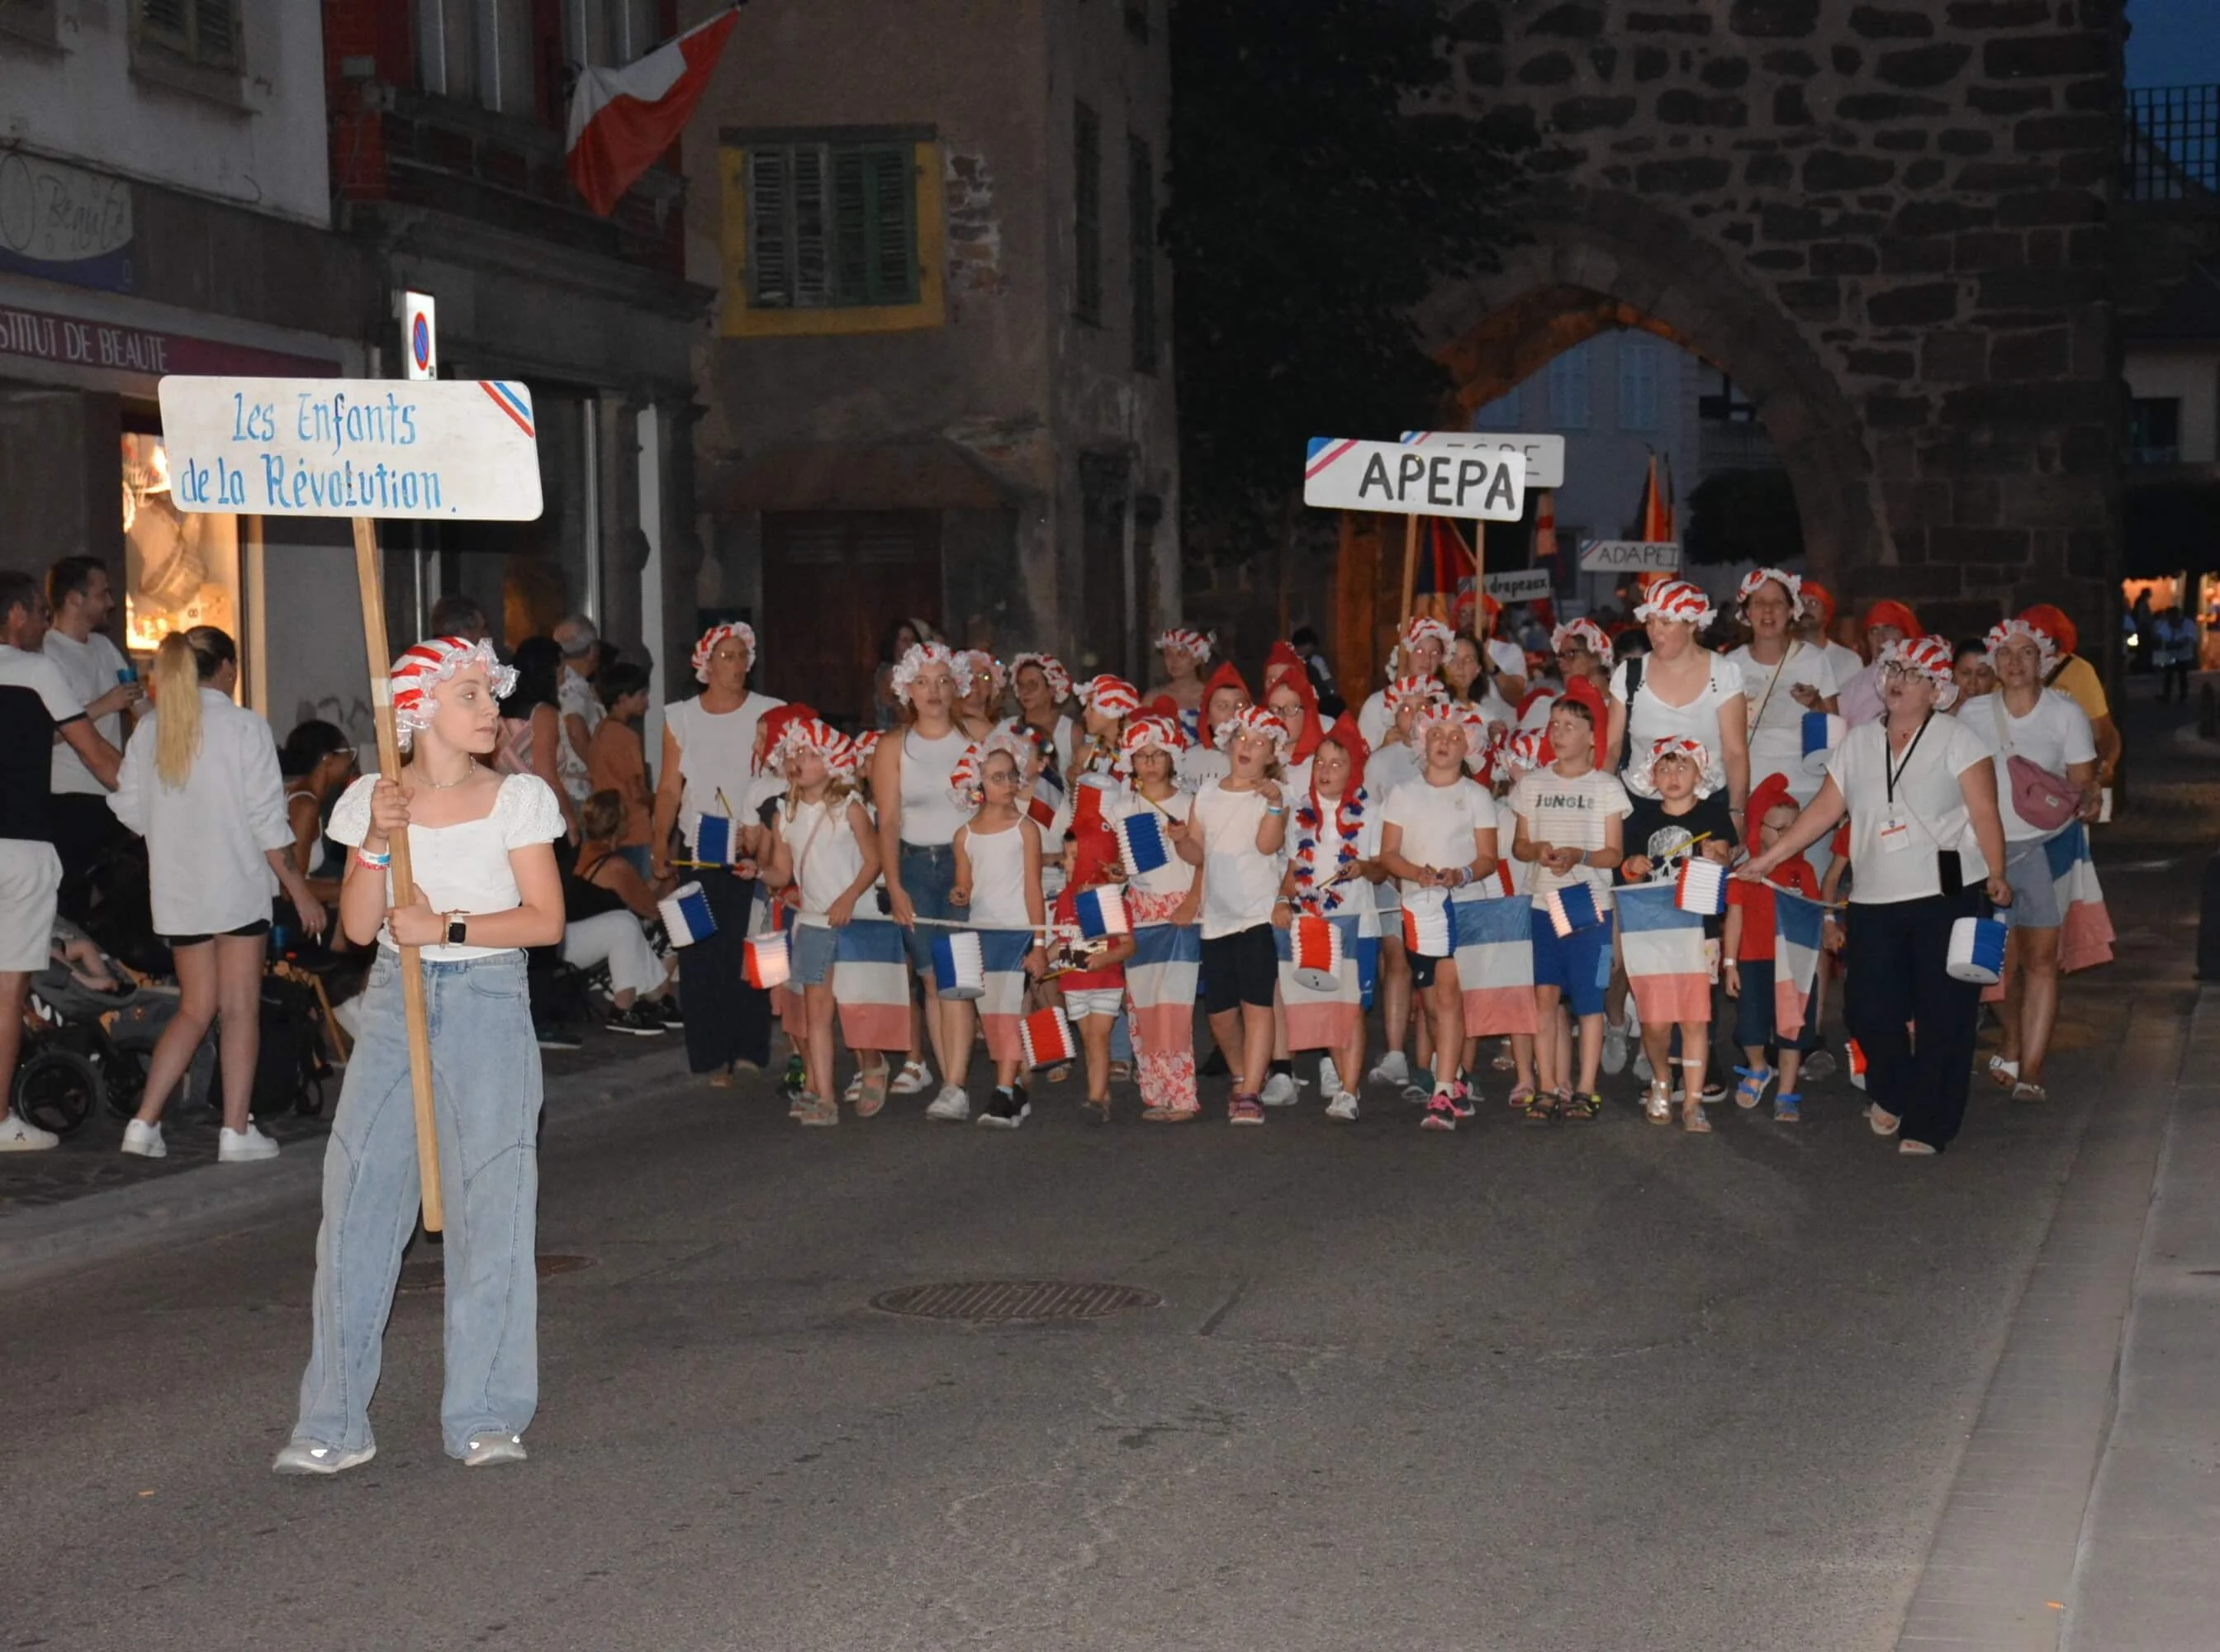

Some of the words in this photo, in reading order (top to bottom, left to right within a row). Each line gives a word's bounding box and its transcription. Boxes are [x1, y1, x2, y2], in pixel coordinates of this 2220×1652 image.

[64, 321, 94, 363] DE
[296, 392, 417, 456] Enfants
[181, 458, 210, 504] de
[1359, 452, 1516, 510] APEPA
[1490, 576, 1547, 597] drapeaux
